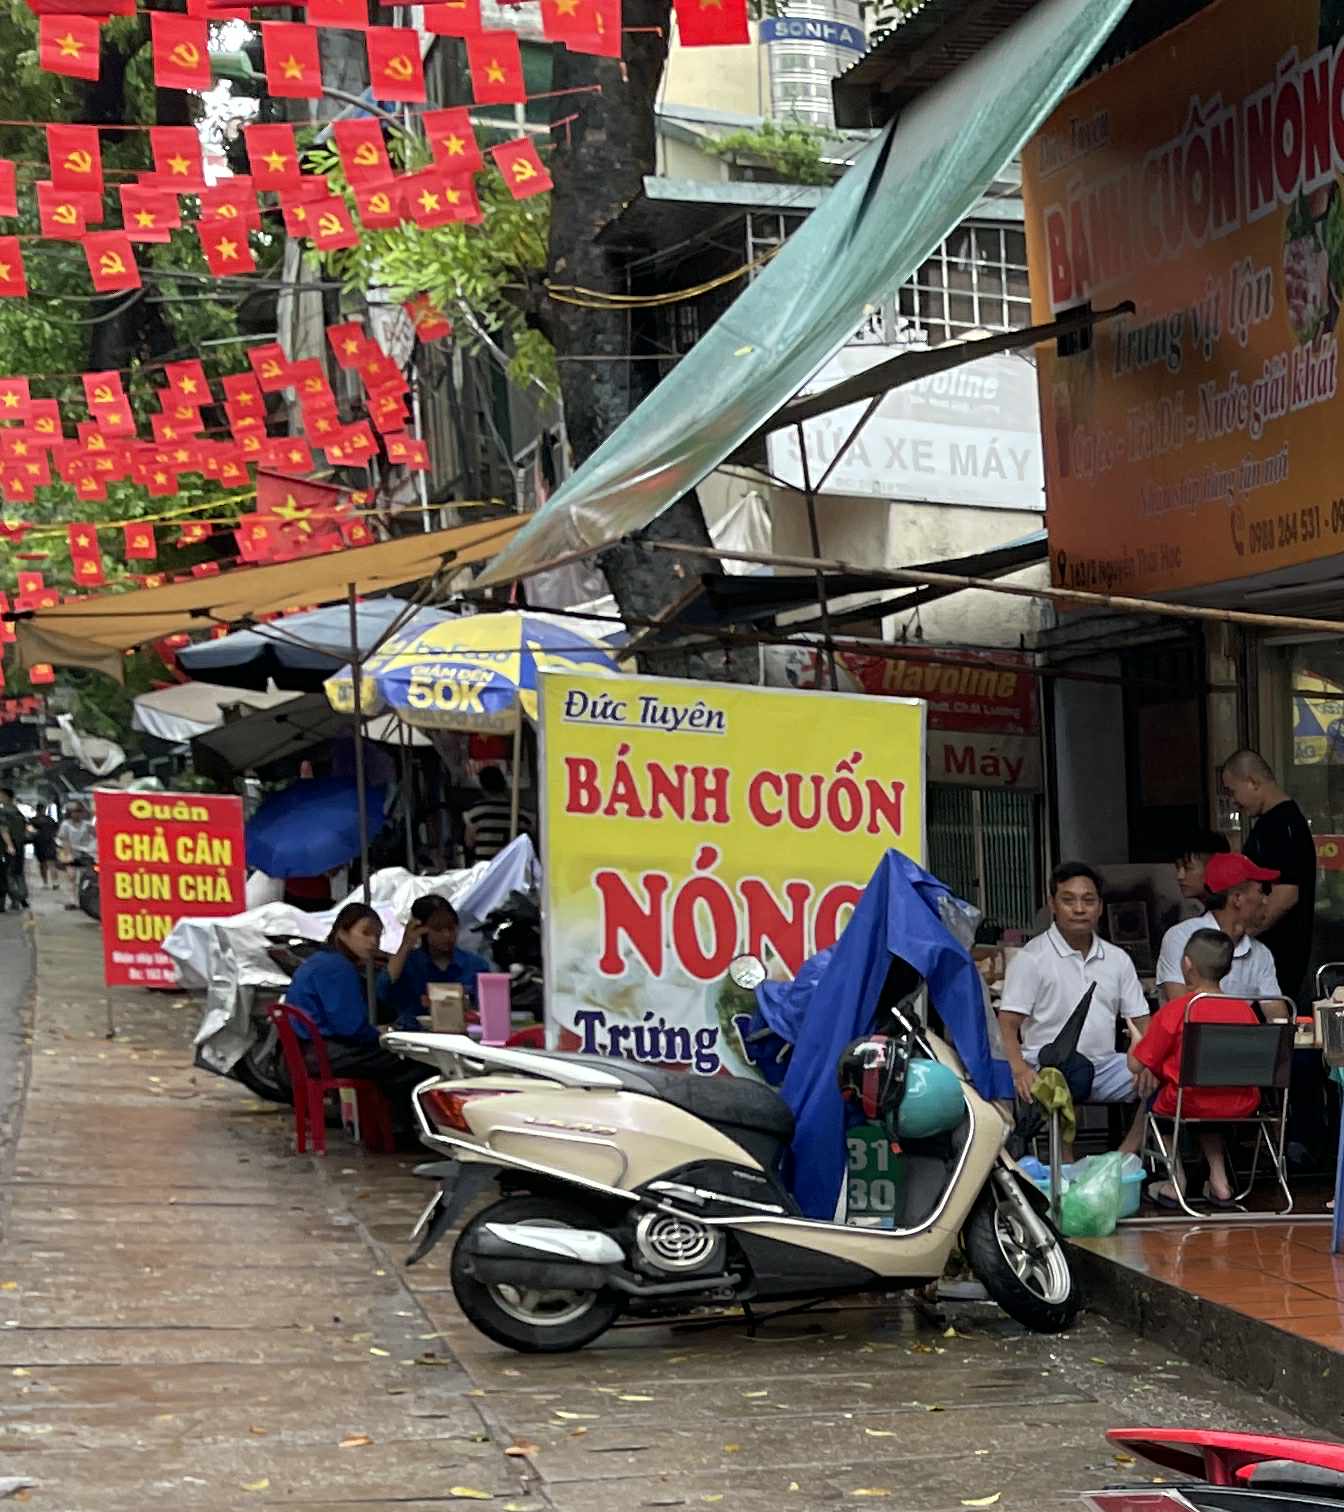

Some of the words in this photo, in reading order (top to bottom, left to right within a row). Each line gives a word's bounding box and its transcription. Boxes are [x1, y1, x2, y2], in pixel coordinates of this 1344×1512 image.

[1229, 256, 1274, 348] lộn
[883, 437, 936, 473] XE
[950, 438, 1031, 481] MÁY
[408, 675, 485, 713] 50K
[882, 658, 1018, 698] Havoline
[564, 690, 626, 721] Đức
[639, 696, 725, 732] Tuyên
[943, 744, 1024, 783] Máy
[564, 742, 730, 823] BÁNH
[748, 751, 905, 836] CUỐN
[114, 826, 170, 862] CHẢ
[114, 868, 172, 900] BÚN
[178, 868, 233, 902] CHẢ
[117, 908, 172, 941] BÚN
[575, 1010, 719, 1073] Trứng
[847, 1139, 889, 1171] 31
